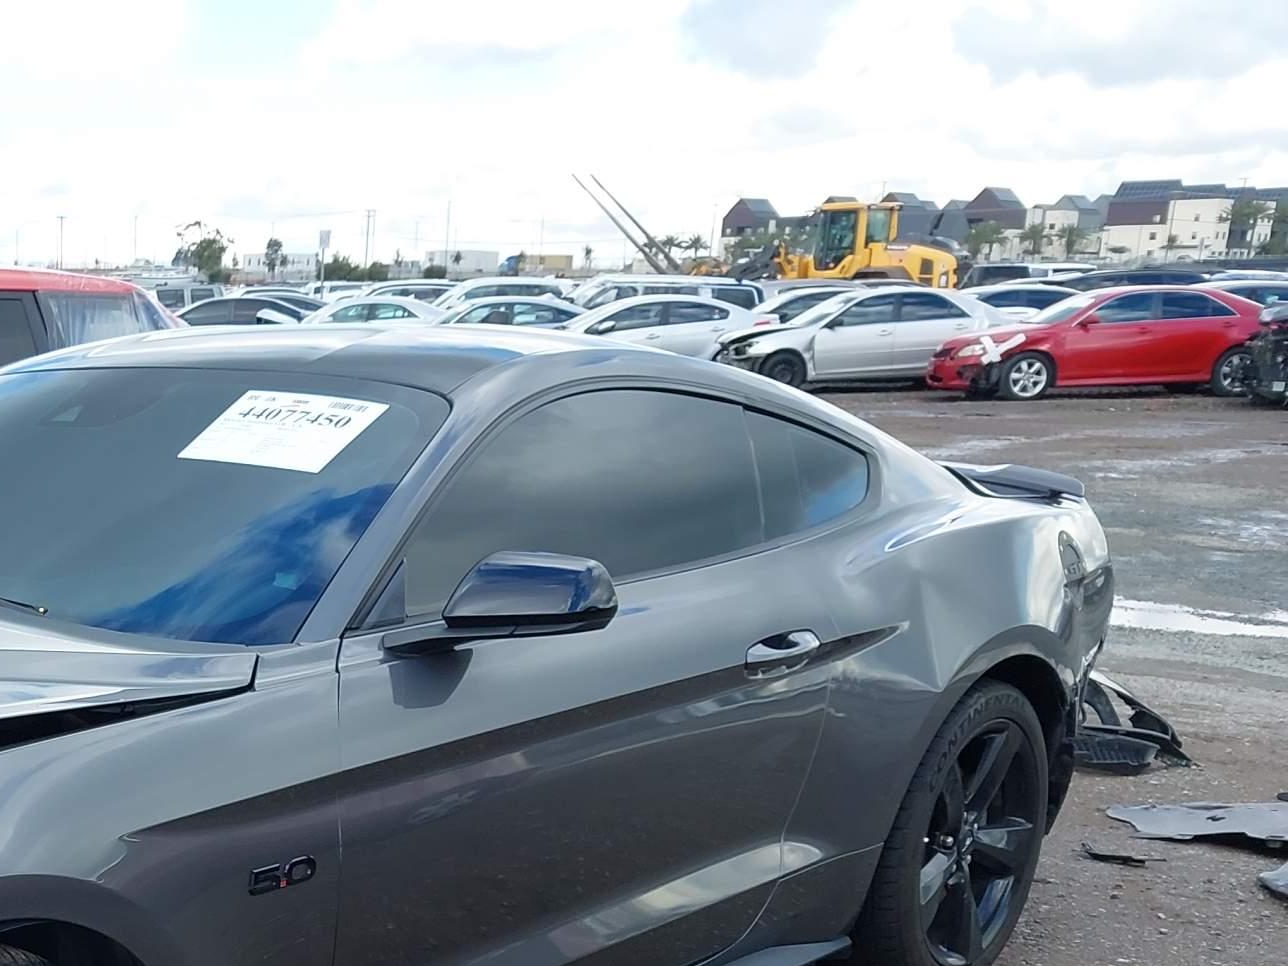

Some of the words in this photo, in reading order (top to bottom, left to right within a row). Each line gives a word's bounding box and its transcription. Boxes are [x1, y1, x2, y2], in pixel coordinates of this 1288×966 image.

[238, 405, 352, 429] 44077450
[929, 692, 1027, 793] CONTINENTAL
[248, 854, 316, 897] 5.0
